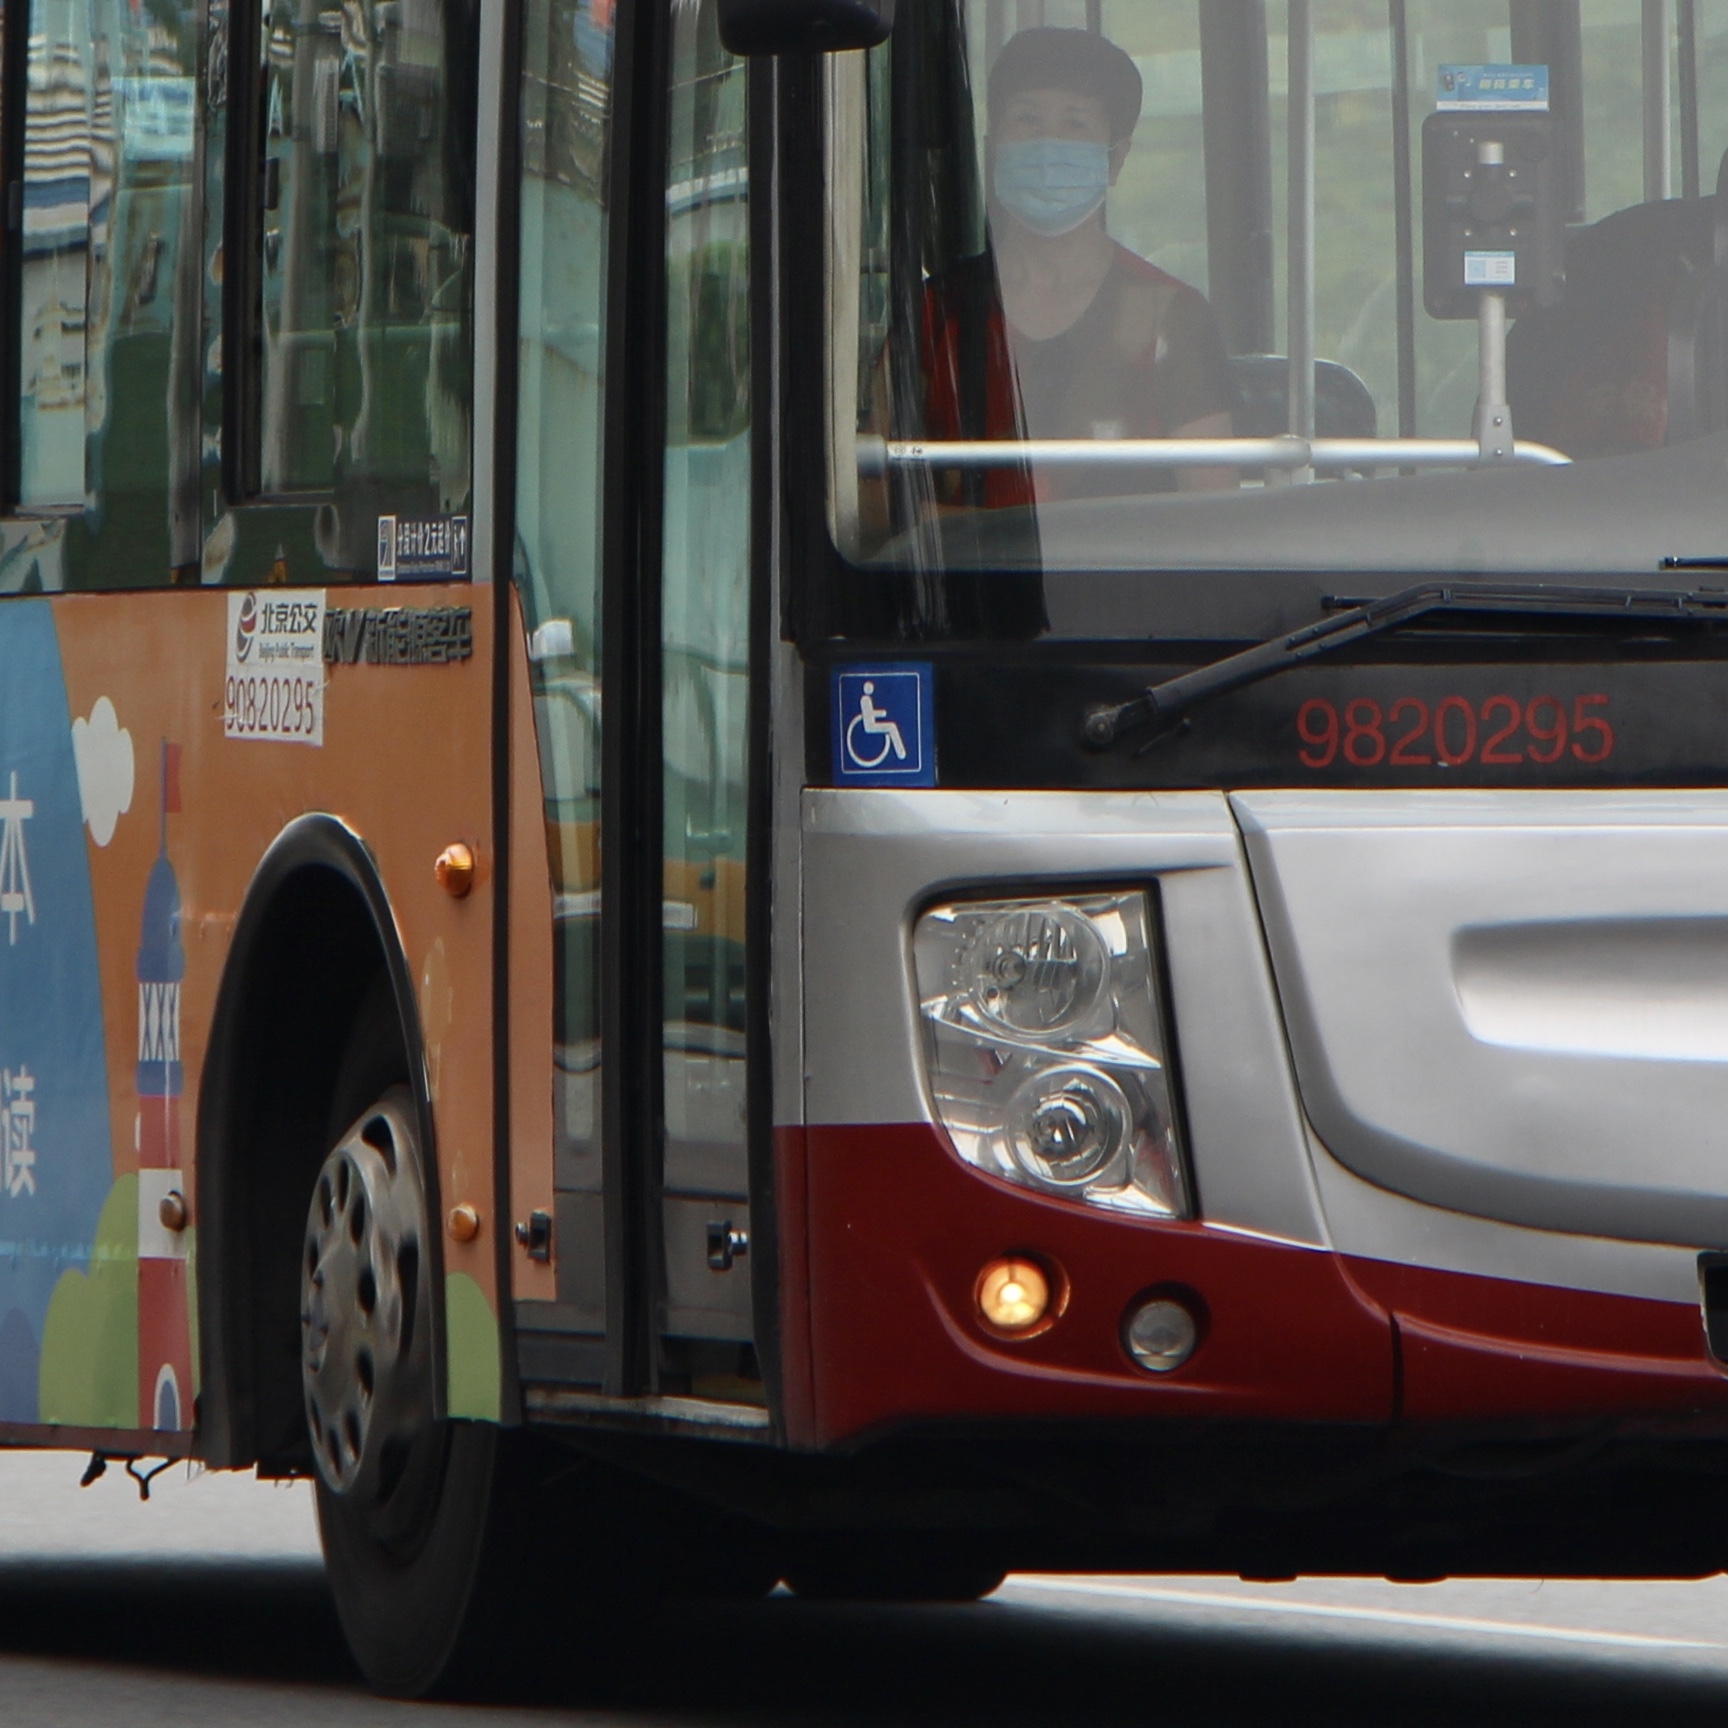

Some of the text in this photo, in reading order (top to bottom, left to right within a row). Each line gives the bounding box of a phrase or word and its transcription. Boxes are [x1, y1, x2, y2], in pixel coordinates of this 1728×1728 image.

[261, 602, 318, 635] 北京公交
[226, 677, 315, 735] 90820295
[1296, 693, 1614, 768] 9820295
